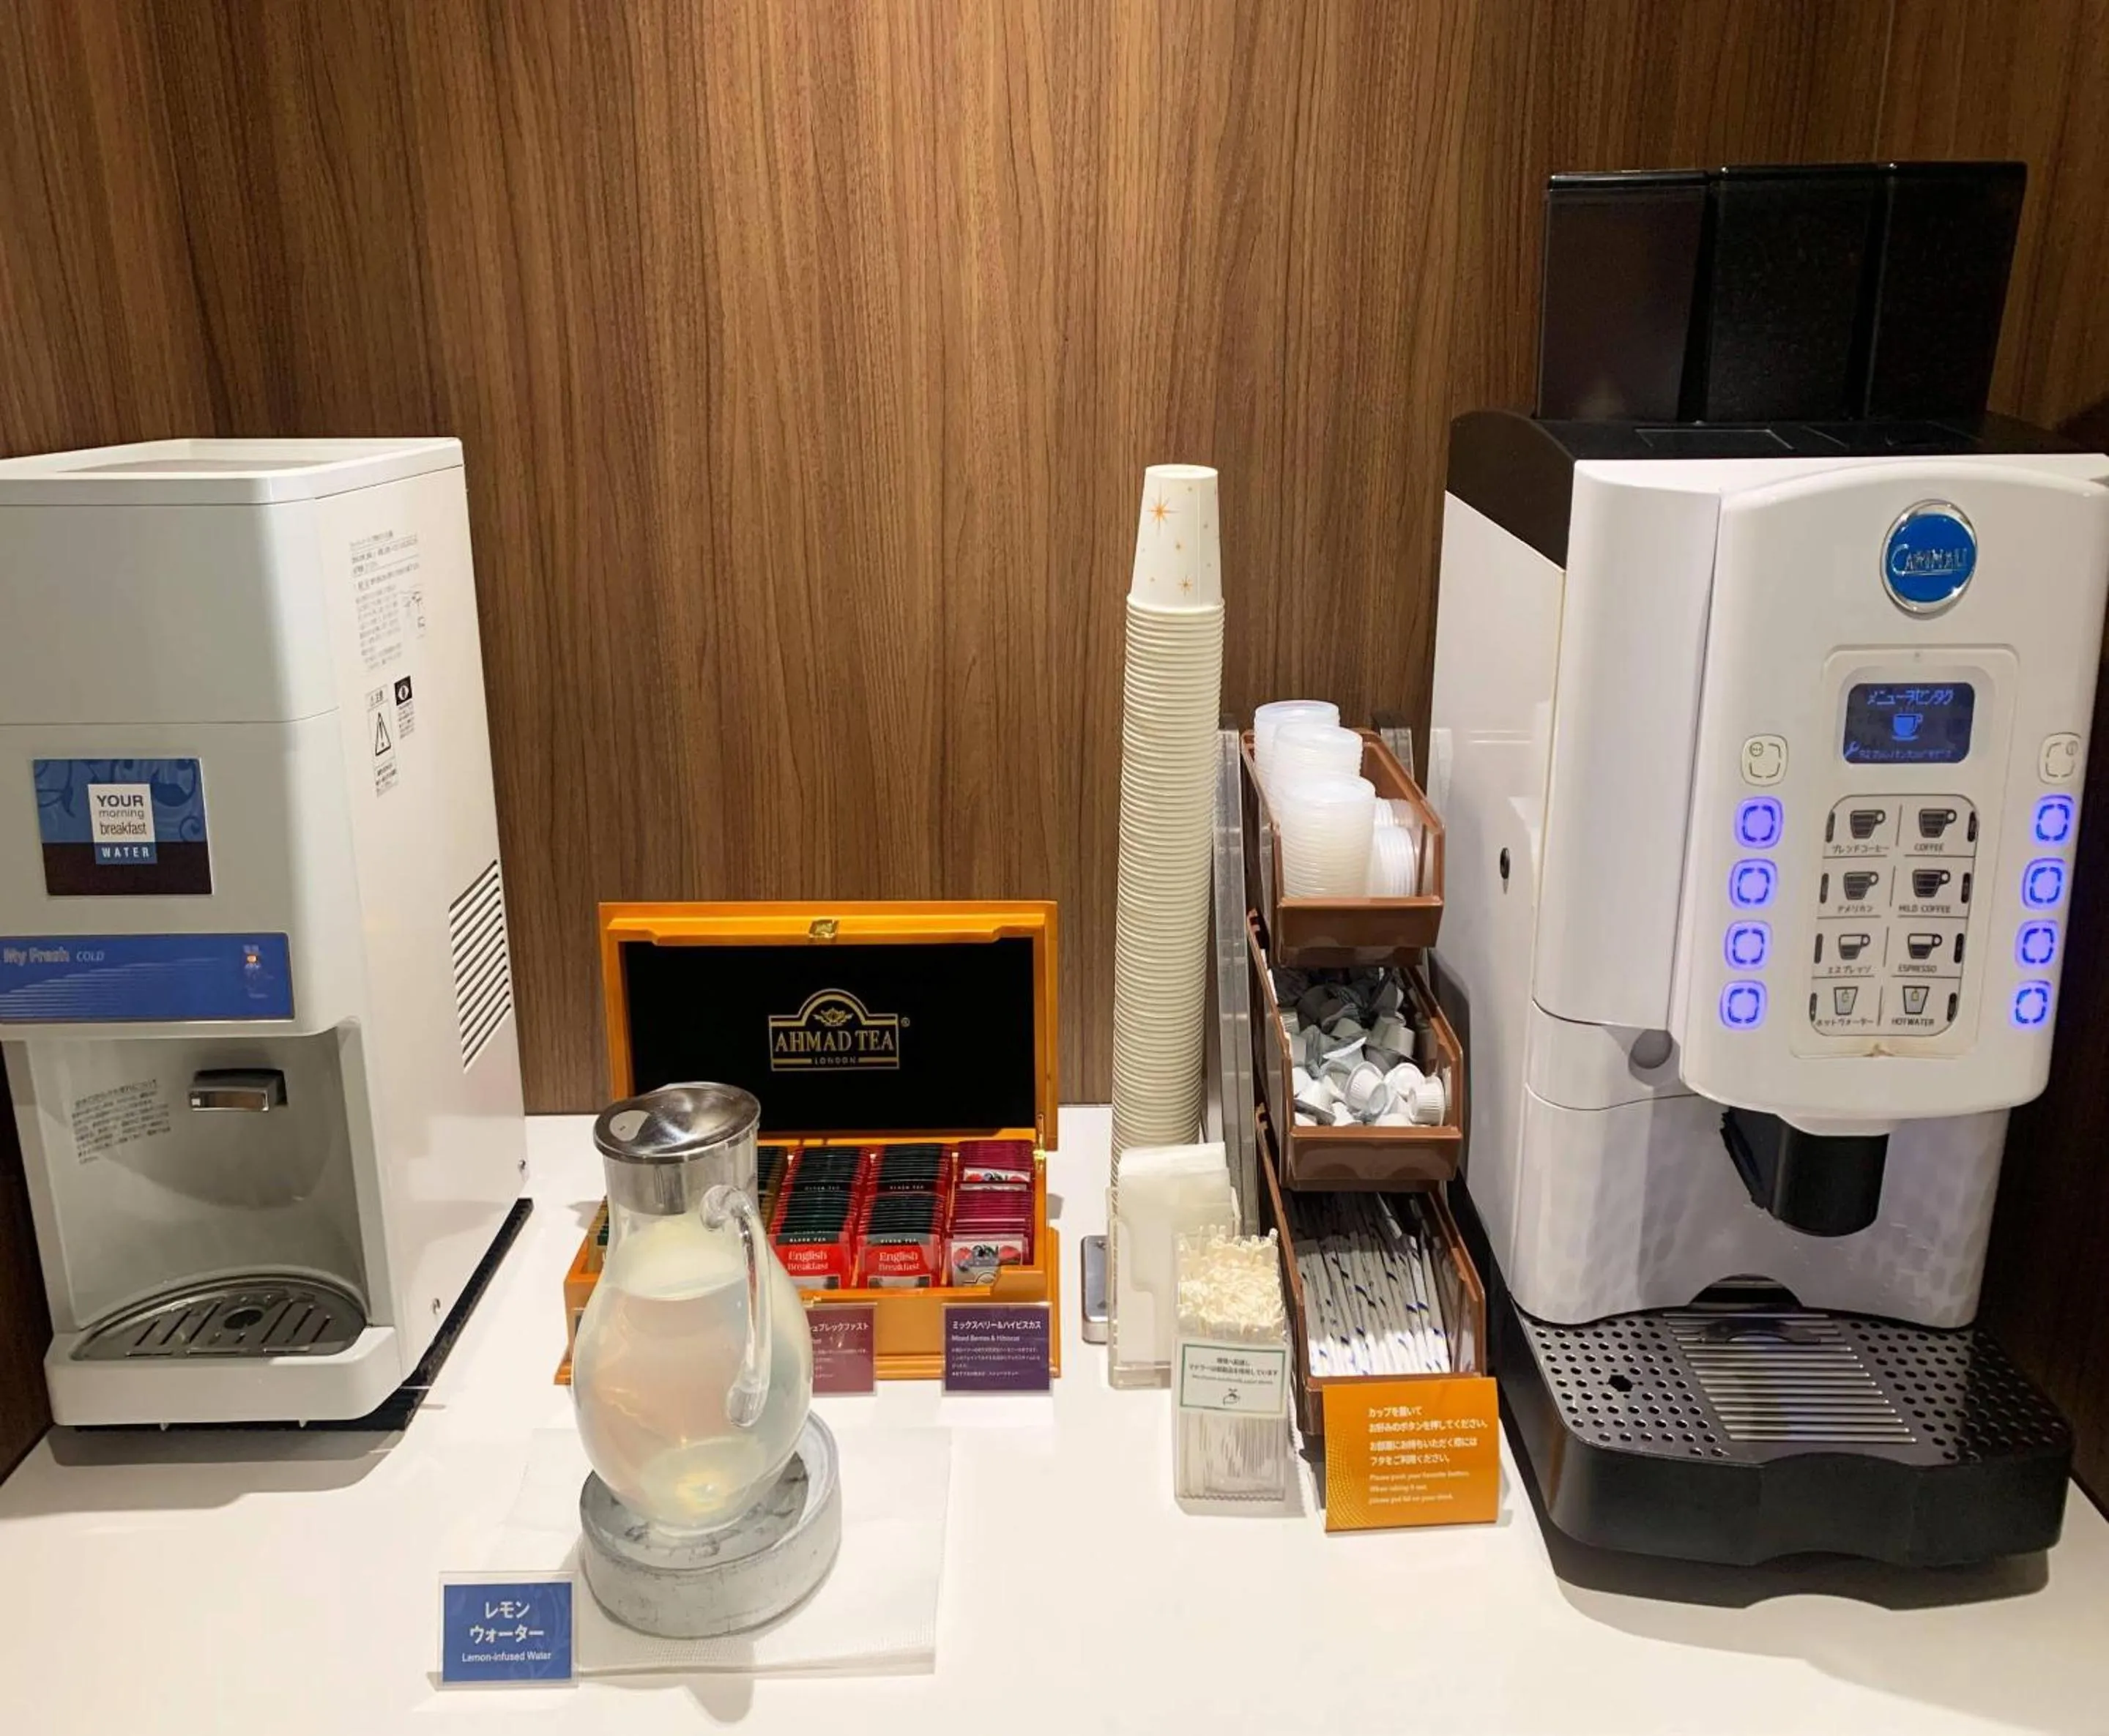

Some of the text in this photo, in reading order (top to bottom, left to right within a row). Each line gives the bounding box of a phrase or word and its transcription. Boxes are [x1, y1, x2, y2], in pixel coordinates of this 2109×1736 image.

[97, 794, 144, 807] YOUR
[98, 808, 145, 819] morning
[100, 822, 147, 835] breakfast
[101, 846, 150, 859] WATER
[1914, 843, 1945, 852] COFFEE
[1899, 904, 1951, 914] MILD COFFEE
[76, 951, 105, 963] COLD
[1897, 964, 1938, 973] ESPRESSO
[775, 1029, 895, 1052] AHMAD TEA
[814, 1057, 856, 1065] LONDON
[788, 1249, 827, 1262] English
[879, 1251, 918, 1263] English
[787, 1262, 829, 1271] Breakfast
[485, 1601, 530, 1620] レモン
[469, 1624, 544, 1644] ウォーター
[461, 1650, 551, 1663] Lemon-infused Water
